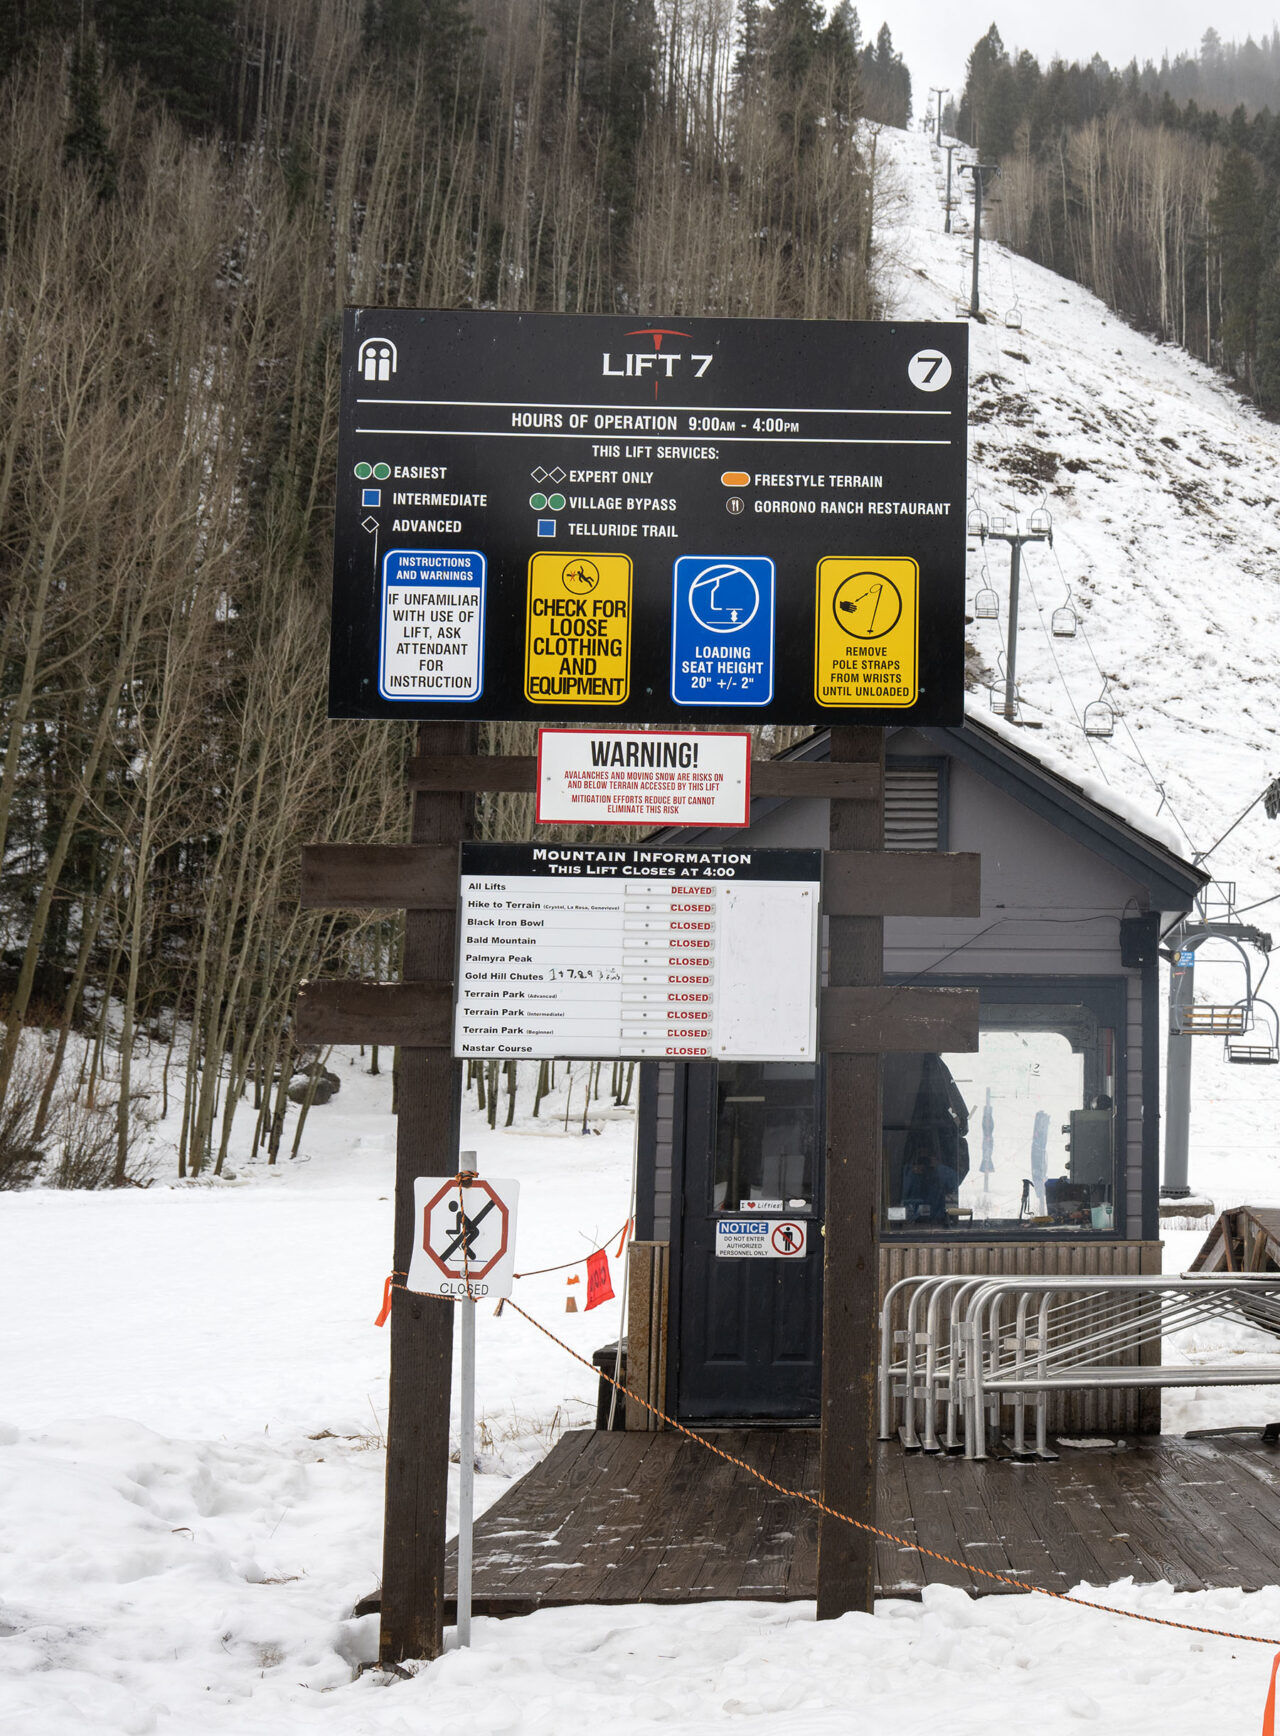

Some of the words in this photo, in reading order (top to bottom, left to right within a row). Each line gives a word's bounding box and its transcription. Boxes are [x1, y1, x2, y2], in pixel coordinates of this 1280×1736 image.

[602, 353, 681, 376] LIFT
[691, 354, 713, 377] 7
[917, 356, 943, 383] 7
[511, 412, 562, 427] HOURS
[569, 413, 588, 428] OF
[594, 414, 677, 430] OPERATION
[688, 416, 735, 431] 9:00AM
[752, 417, 799, 432] 4:00PM
[591, 444, 620, 457] THIS
[625, 445, 652, 458] LIFT
[656, 446, 719, 459] SERVICES:
[394, 466, 447, 479] EASIEST
[569, 470, 618, 483] EXPERT
[622, 471, 653, 483] ONLY
[754, 474, 824, 487] FREESTYLE
[828, 475, 882, 487] TERRAIN
[393, 492, 487, 506] INTERMEDIATE
[569, 496, 622, 509] VILLAGE
[626, 497, 676, 511] BYPASS
[754, 500, 815, 513] GORRONO
[820, 501, 863, 514] RANCH
[868, 502, 950, 515] RESTAURANT
[392, 519, 461, 532] ADVANCED
[568, 523, 637, 536] TELLURIDE
[641, 524, 678, 537] TRAIL
[399, 556, 471, 567] INSTRUCTIONS
[396, 570, 417, 579] AND
[420, 570, 473, 581] WARNINGS
[388, 594, 399, 605] IF
[404, 594, 479, 607] UNFAMILIAR
[532, 598, 587, 617] CHECK
[592, 599, 627, 618] FOR
[392, 609, 425, 621] WITH
[430, 610, 453, 622] USE
[458, 610, 474, 622] OF
[550, 618, 607, 636] LOOSE
[403, 626, 432, 640] LIFT,
[436, 626, 461, 639] ASK
[396, 642, 468, 655] ATTENDANT
[532, 638, 622, 657] CLOTHING
[695, 646, 750, 659] LOADING
[845, 646, 887, 656] REMOVE
[419, 659, 443, 671] FOR
[559, 658, 596, 675] AND
[681, 661, 713, 674] SEAT
[717, 662, 763, 675] HEIGHT
[832, 659, 857, 669] POLE
[861, 659, 900, 670] STRAPS
[390, 675, 471, 688] INSTRUCTION
[691, 676, 711, 688] 20"
[717, 676, 737, 690] +/-
[741, 676, 754, 689] 2"
[830, 672, 859, 682] FROM
[862, 673, 901, 683] WRISTS
[529, 677, 625, 696] EQUIPMENT
[822, 686, 852, 696] UNTIL
[855, 686, 909, 696] UNLOADED
[590, 741, 698, 768] WARNING!
[564, 771, 608, 780] AVALANCHES
[610, 771, 625, 780] AND
[626, 772, 653, 781] MOVING
[655, 772, 675, 781] SNOW
[677, 772, 690, 781] ARE
[692, 772, 712, 781] RISKS
[713, 773, 723, 782] ON
[567, 780, 582, 788] AND
[583, 780, 607, 789] BELOW
[609, 780, 638, 789] TERRAIN
[639, 781, 675, 790] ACCESSED
[677, 782, 686, 790] BY
[687, 782, 703, 791] THIS
[705, 782, 719, 791] LIFT
[571, 794, 611, 803] MITIGATION
[613, 795, 642, 804] EFFORTS
[644, 795, 670, 804] REDUCE
[672, 796, 686, 805] BUT
[688, 796, 715, 805] CANNOT
[607, 804, 644, 813] ELIMINATE
[645, 804, 661, 813] THIS
[662, 805, 679, 814] RISK
[484, 882, 506, 890] Lifts
[671, 886, 712, 894] DELAYED
[467, 900, 489, 908] Hike
[670, 903, 711, 912] CLOSED
[467, 918, 494, 926] Black
[497, 918, 517, 926] Iron
[669, 921, 710, 930] CLOSED
[491, 936, 536, 944] Mountain
[669, 939, 710, 947] CLOSED
[465, 954, 505, 963] Palmyra
[508, 954, 532, 962] Peak
[668, 957, 709, 965] CLOSED
[490, 972, 506, 980] Hill
[509, 972, 543, 980] Chutes
[668, 975, 709, 983] CLOSED
[502, 990, 524, 998] Park
[667, 993, 708, 1001] CLOSED
[463, 1007, 498, 1015] Terrain
[501, 1008, 524, 1016] Park
[666, 1011, 708, 1019] CLOSED
[501, 1026, 523, 1034] Park
[667, 1029, 707, 1037] CLOSED
[497, 1044, 532, 1052] Course
[665, 1047, 708, 1056] CLOSED
[721, 1223, 767, 1233] NOTICE
[439, 1282, 489, 1295] CLOSED
